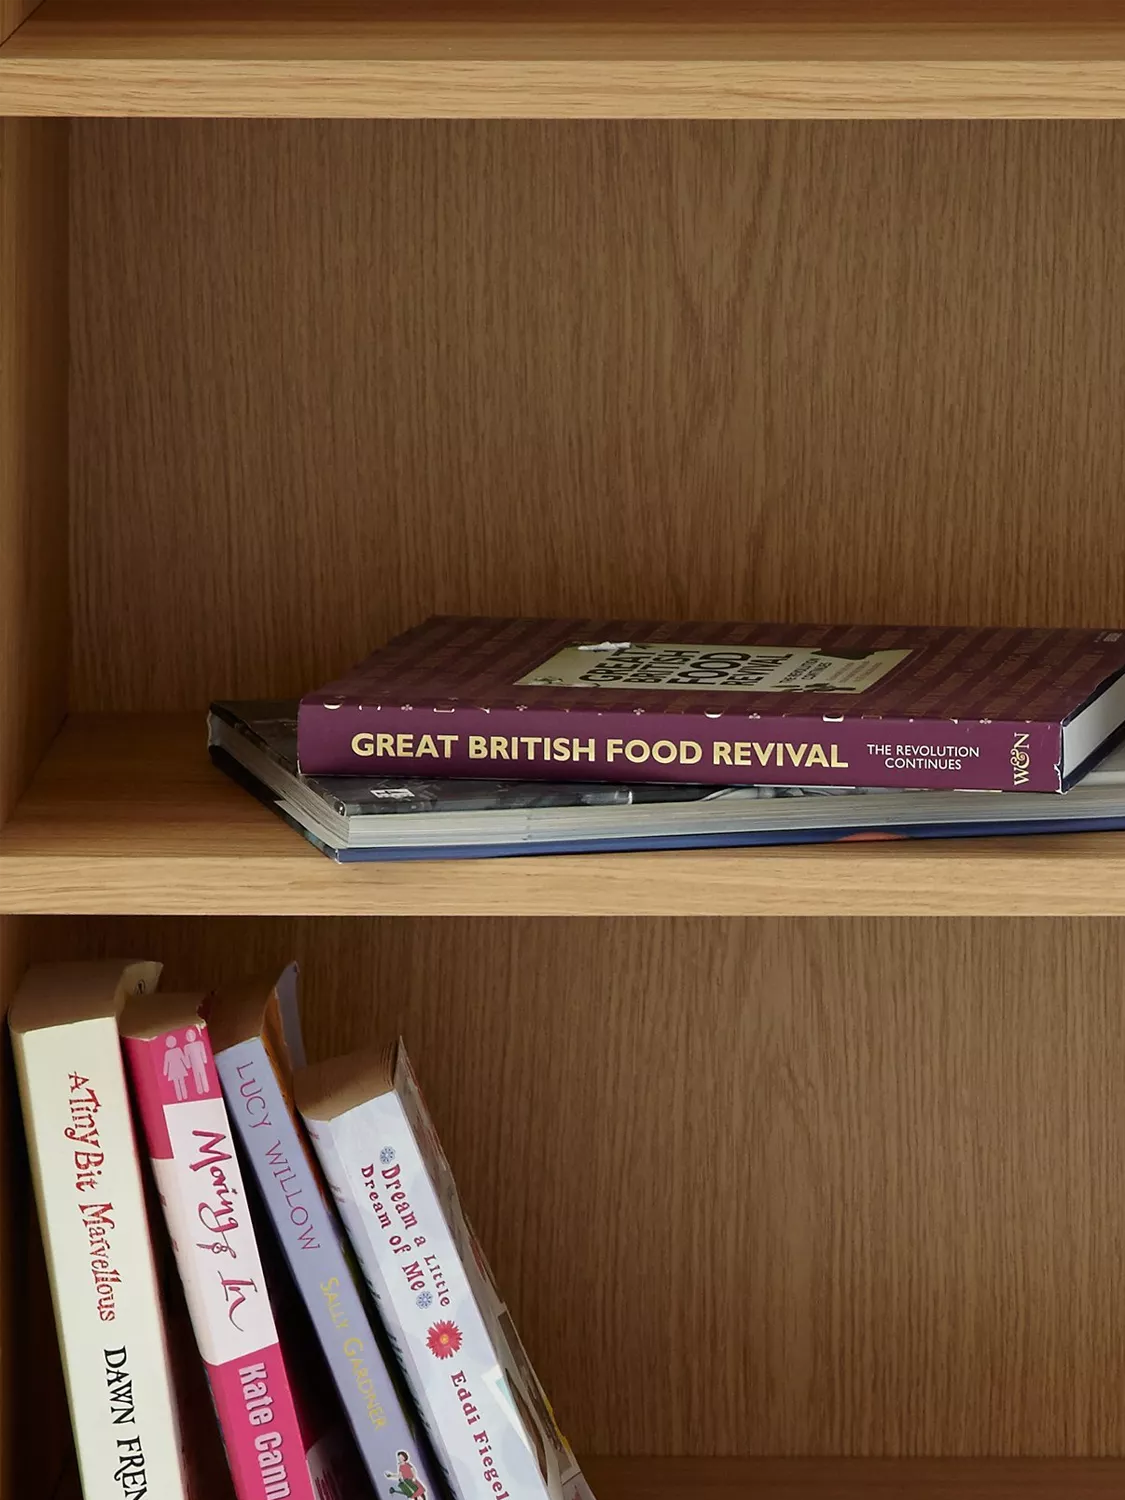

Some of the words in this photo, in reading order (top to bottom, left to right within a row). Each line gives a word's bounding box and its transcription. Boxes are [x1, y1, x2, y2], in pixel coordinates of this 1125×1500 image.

[579, 649, 656, 683] GREAT
[622, 650, 700, 684] BRITISH
[666, 650, 751, 685] FOOD
[350, 731, 459, 758] GREAT
[468, 735, 596, 762] BRITISH
[606, 738, 702, 766] FOOD
[713, 741, 849, 769] REVIVAL
[867, 743, 893, 756] THE
[895, 744, 980, 759] REVOLUTION
[885, 757, 962, 771] CONTINUES
[68, 1071, 90, 1093] A
[64, 1088, 102, 1149] Tiny
[74, 1150, 105, 1192] Bit
[235, 1061, 272, 1131] LUCY
[265, 1139, 321, 1252] WILLOW
[361, 1163, 392, 1229] Dream
[389, 1234, 412, 1255] of
[401, 1261, 425, 1292] Me
[381, 1163, 418, 1230] Dream
[413, 1235, 428, 1248] a
[423, 1254, 451, 1308] Little
[78, 1202, 122, 1323] Marvellous
[320, 1276, 349, 1329] SALLY
[343, 1337, 387, 1431] GARDNER
[103, 1345, 136, 1425] DAWN
[238, 1362, 274, 1427] Kate
[451, 1369, 481, 1426] Eddi
